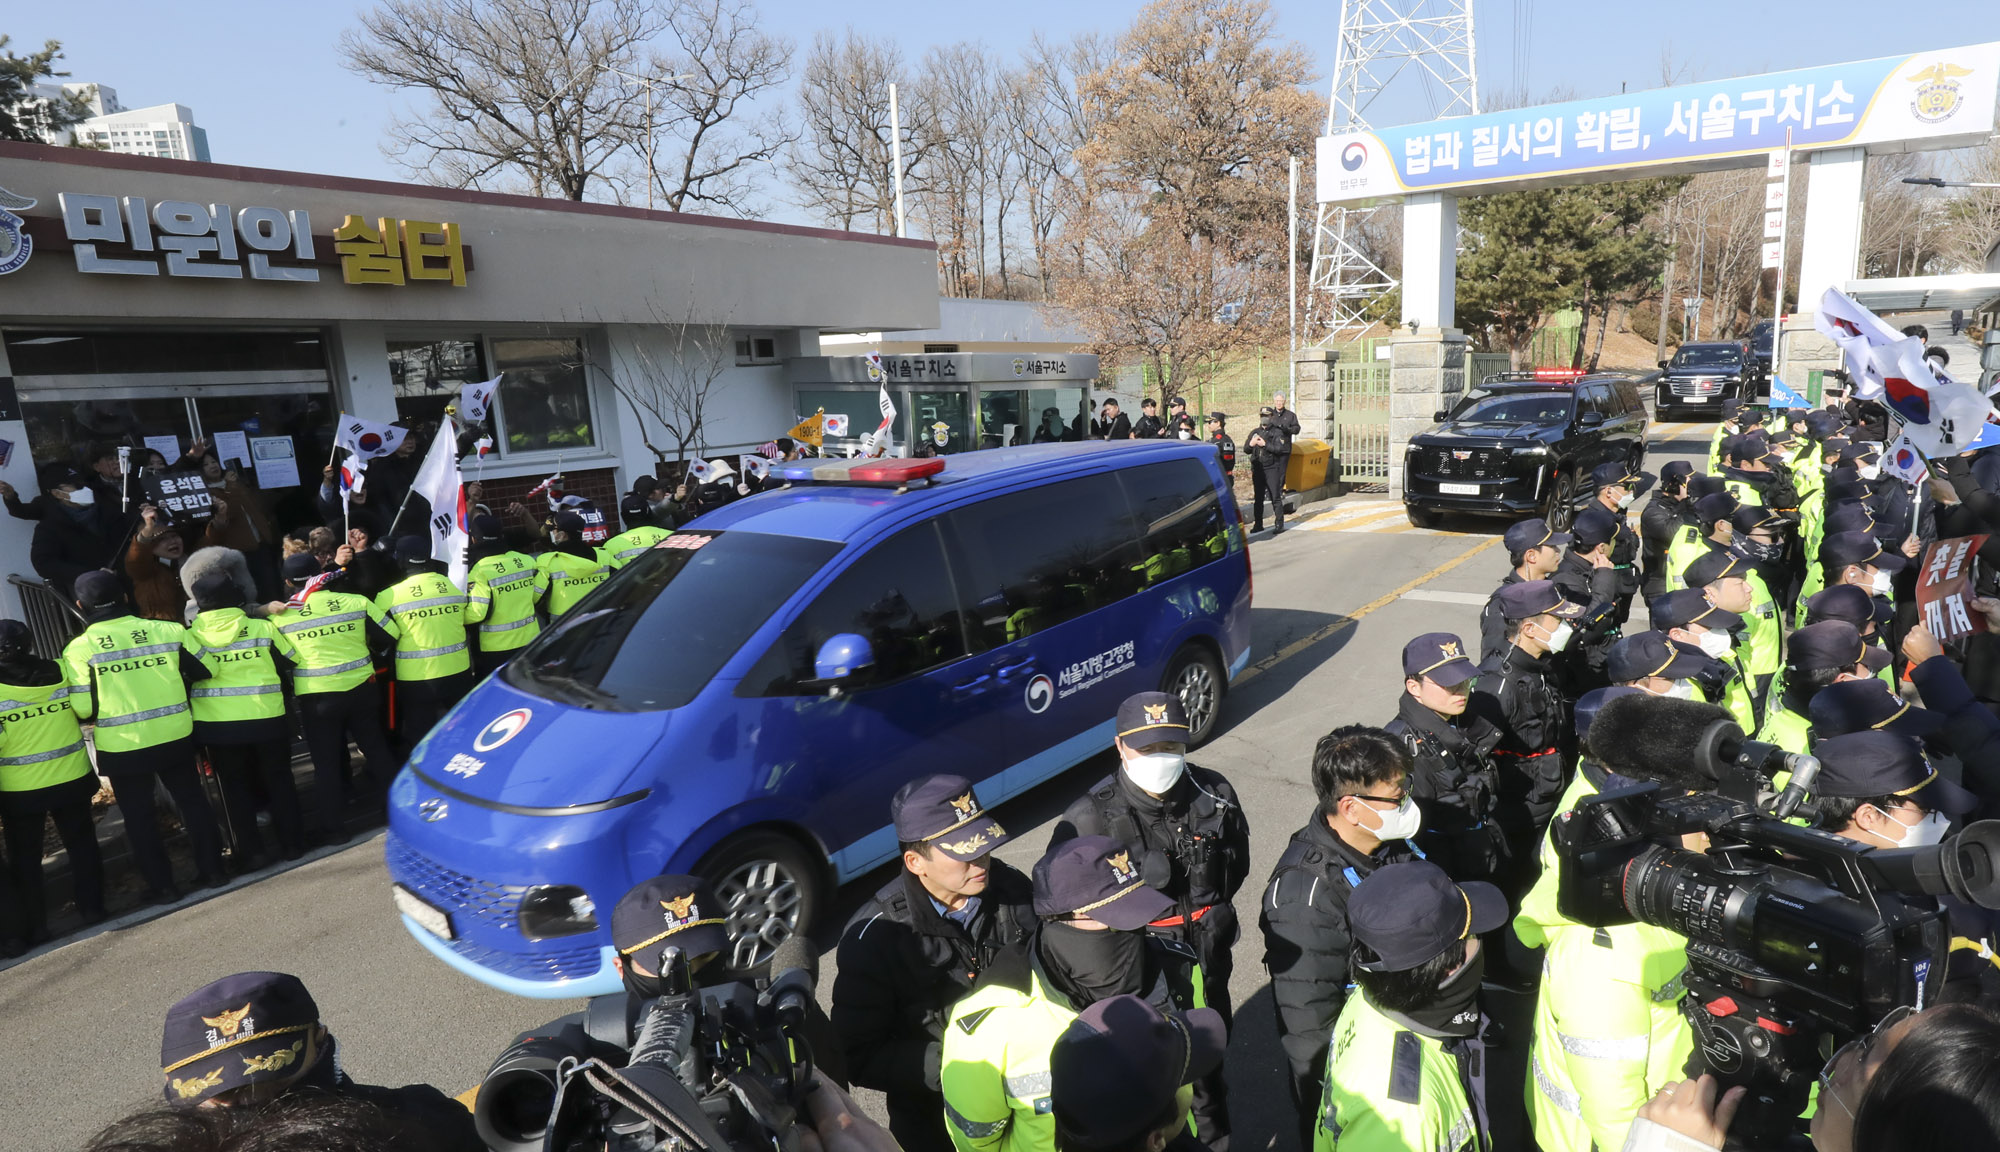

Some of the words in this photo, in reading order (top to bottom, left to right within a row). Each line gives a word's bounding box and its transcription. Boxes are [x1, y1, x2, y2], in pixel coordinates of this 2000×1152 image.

[1404, 130, 1463, 176] 법과
[1471, 116, 1563, 165] 질서의
[1574, 106, 1652, 152] 확립,
[1663, 79, 1855, 142] 서울구치소
[1340, 177, 1368, 191] 법무부
[58, 191, 320, 282] 민원인
[332, 214, 467, 287] 쉼터
[887, 359, 957, 378] 서울구치소
[1026, 359, 1067, 375] 서울구치소
[160, 475, 206, 494] 윤석열
[493, 557, 524, 574] 경찰
[410, 581, 448, 597] 경찰
[498, 578, 534, 595] POLICE
[409, 604, 460, 620] POLICE
[97, 629, 149, 649] 경찰
[297, 622, 356, 641] POLICE
[97, 656, 167, 676] POLICE
[1058, 640, 1134, 687] 서울지방교정청
[1059, 685, 1078, 699] Seoul
[1077, 674, 1104, 691] Regional
[1767, 894, 1805, 910] Panasonic
